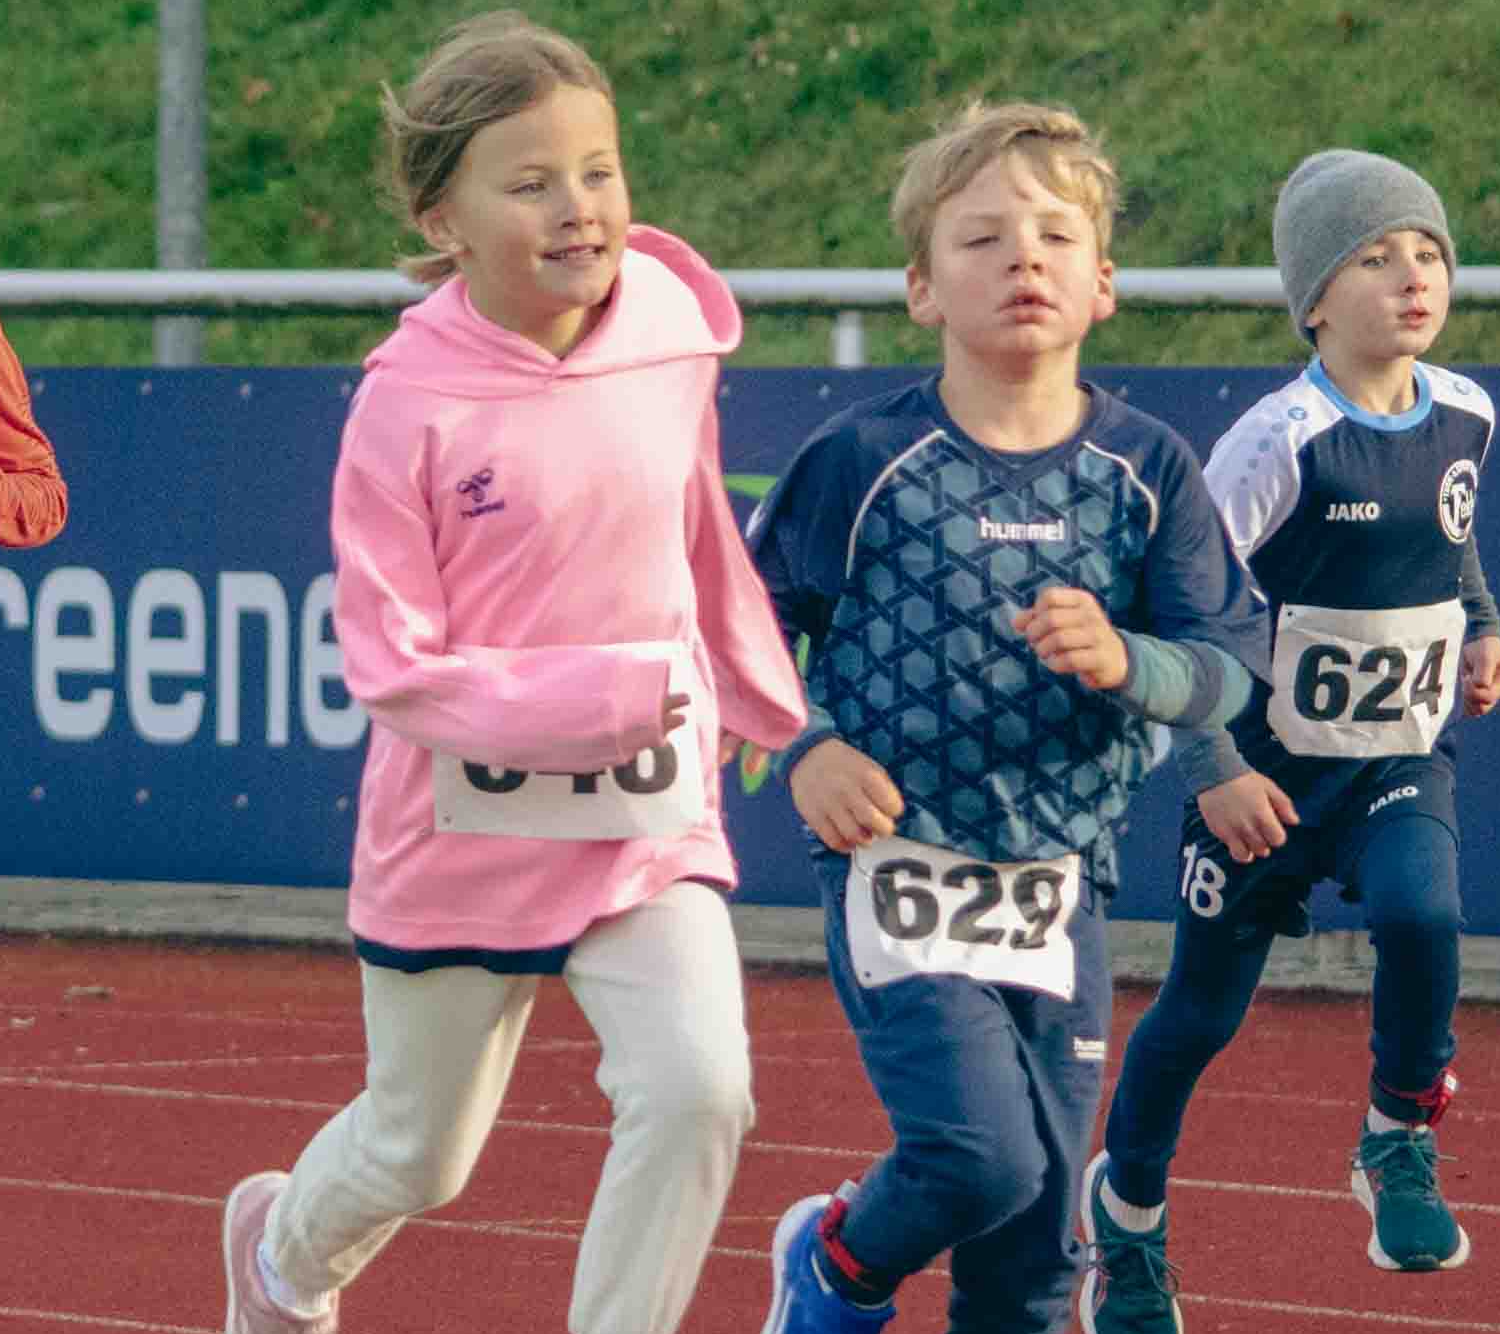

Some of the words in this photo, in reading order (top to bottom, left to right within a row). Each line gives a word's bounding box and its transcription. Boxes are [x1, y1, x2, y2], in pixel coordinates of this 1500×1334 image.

[979, 516, 1065, 540] hummel
[1325, 501, 1381, 522] JAKO
[1293, 638, 1448, 723] 624
[1367, 785, 1419, 817] JAKO
[872, 858, 1066, 950] 629
[1181, 843, 1226, 918] 18
